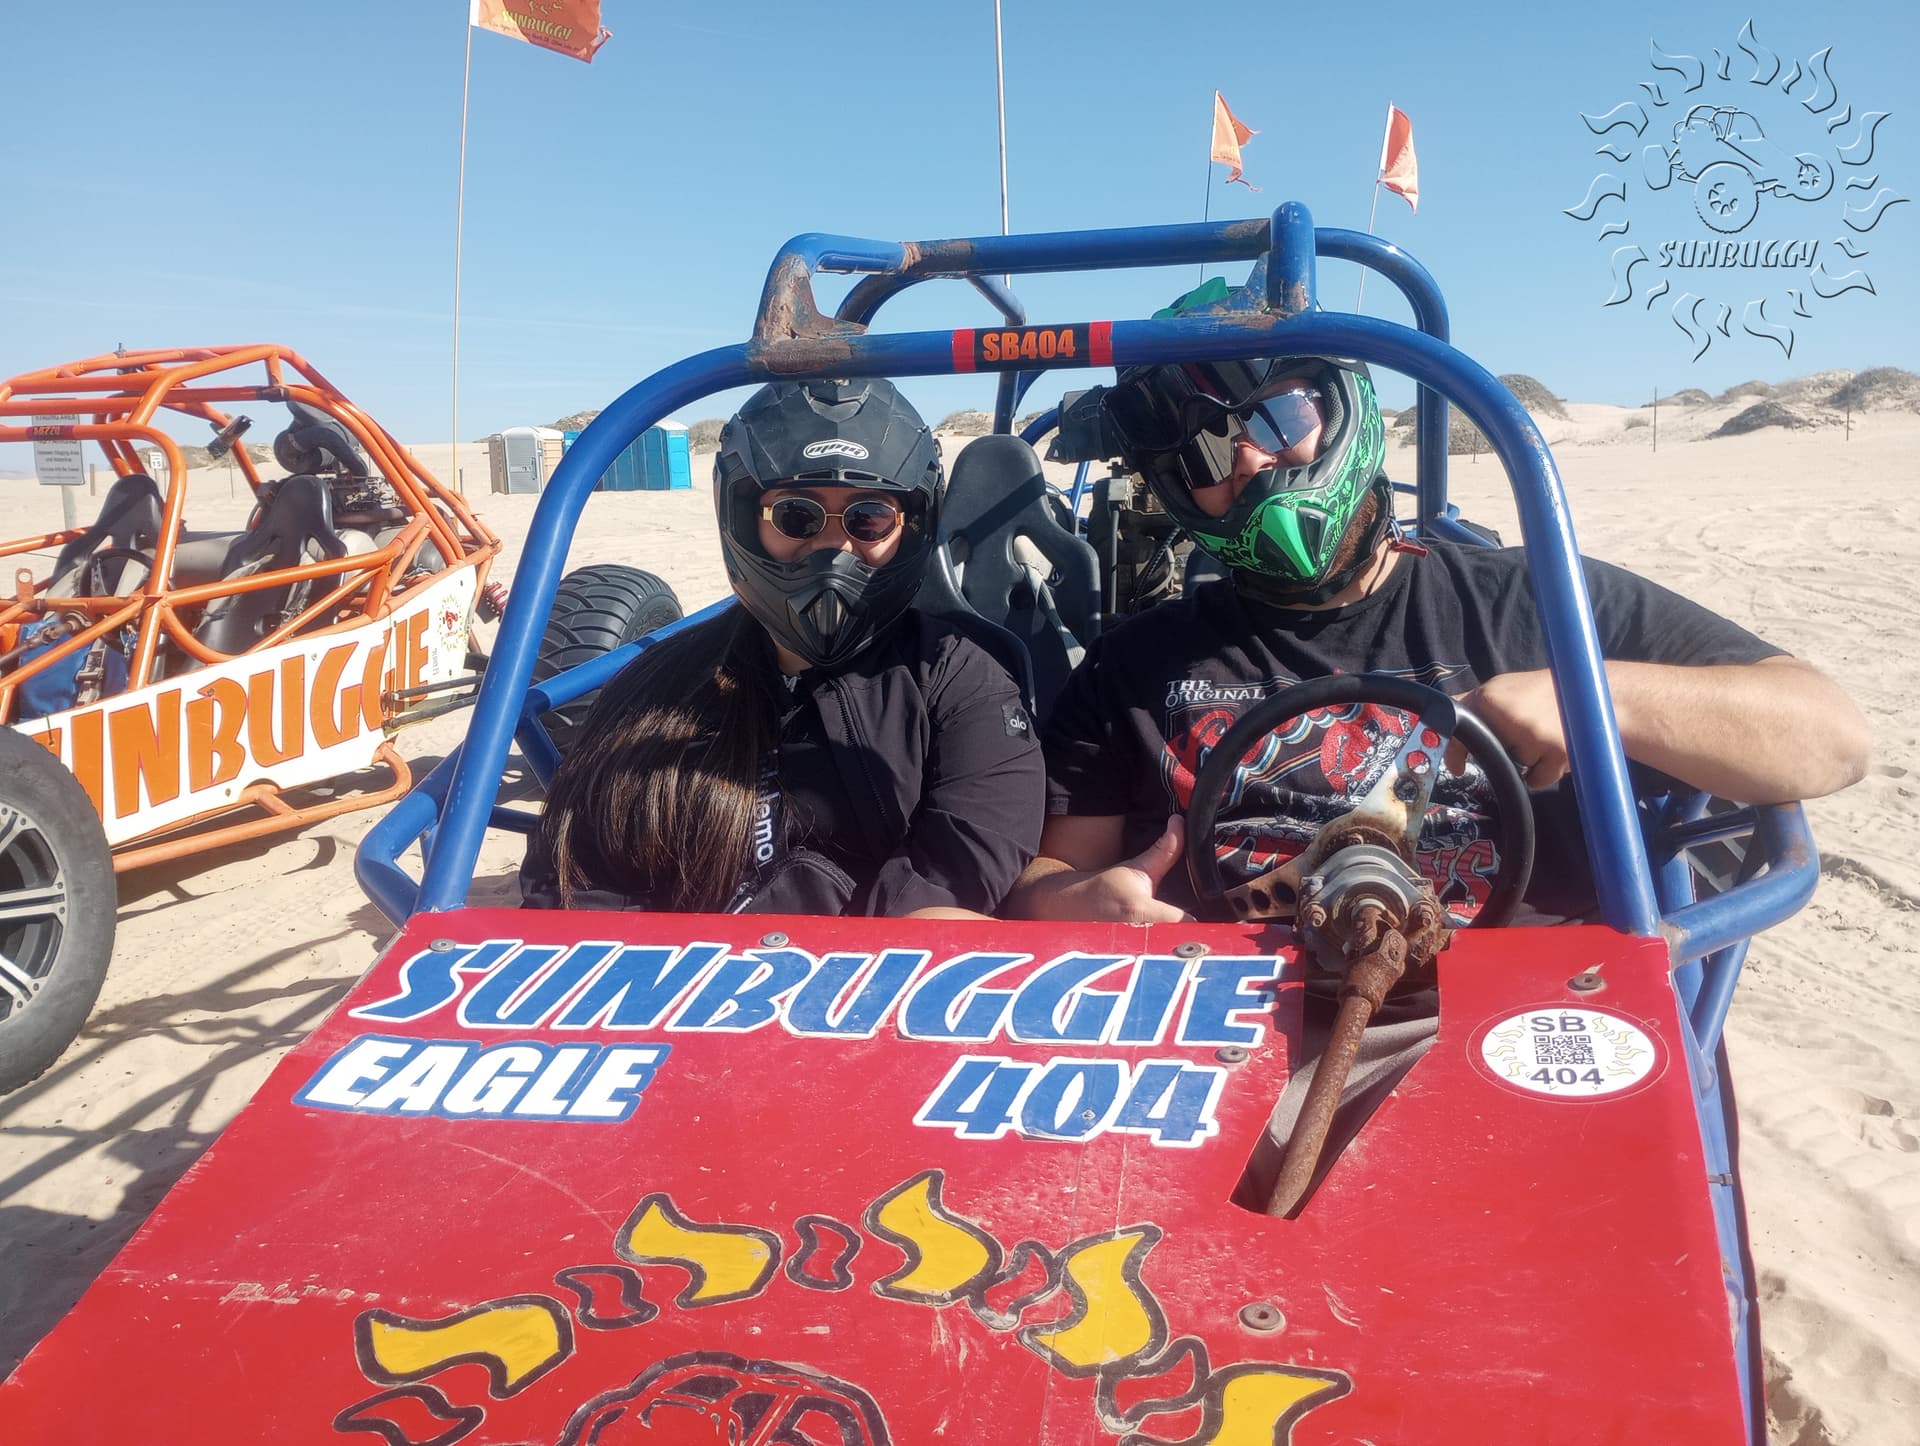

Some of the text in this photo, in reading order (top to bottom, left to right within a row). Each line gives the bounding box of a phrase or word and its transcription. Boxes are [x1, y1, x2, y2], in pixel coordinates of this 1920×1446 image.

[982, 330, 1076, 361] SB404
[1167, 680, 1212, 695] THE
[1165, 689, 1266, 708] ORIGINAL
[1010, 715, 1027, 730] alo
[348, 939, 1286, 1047] SUNBUGGIE
[1531, 1016, 1586, 1033] SB
[1530, 1067, 1604, 1085] 404
[294, 1035, 1227, 1147] EAGLE 404
